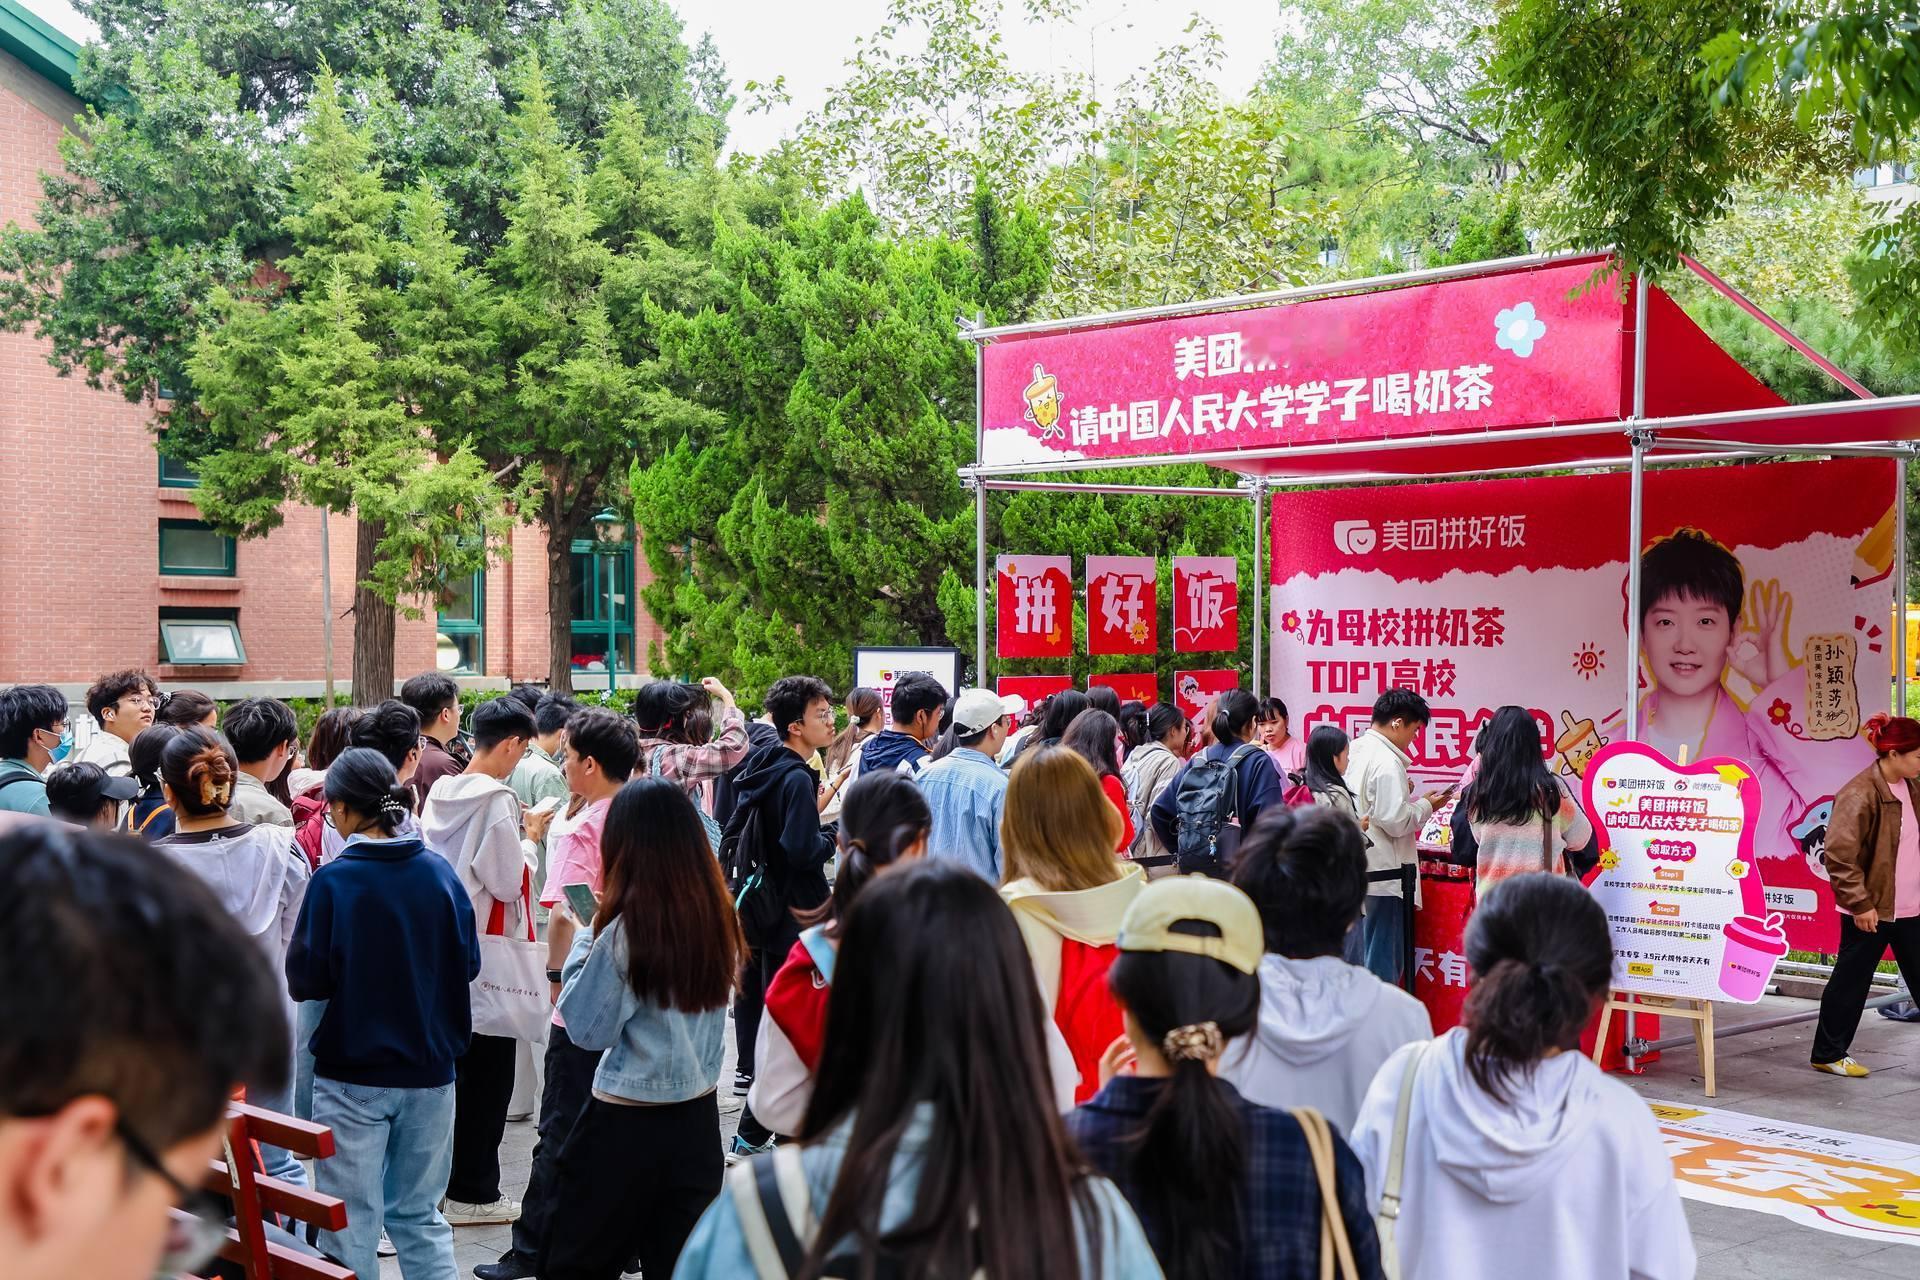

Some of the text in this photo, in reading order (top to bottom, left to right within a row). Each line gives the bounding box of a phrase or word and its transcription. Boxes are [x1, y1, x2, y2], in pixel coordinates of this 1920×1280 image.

[1069, 364, 1493, 447] 请中国人民大学学子喝奶茶
[1382, 514, 1526, 551] 美团拼好饭
[1015, 578, 1056, 634] 拼
[1101, 574, 1144, 634] 好
[1187, 575, 1225, 629] 饭
[1306, 608, 1505, 647] 为母校拼奶茶
[1307, 659, 1456, 697] TOP1高校
[1814, 645, 1823, 727] 美团美味生活代言人
[1825, 644, 1845, 709] 孙颖莎
[1618, 779, 1665, 790] 美团拼好饭
[1607, 814, 1740, 831] 请中国人民大学学子喝奶茶
[1640, 798, 1706, 814] 美团拼好饭
[1650, 844, 1692, 857] 领取方式
[1660, 870, 1679, 879] Step1
[1656, 905, 1676, 913] Step2
